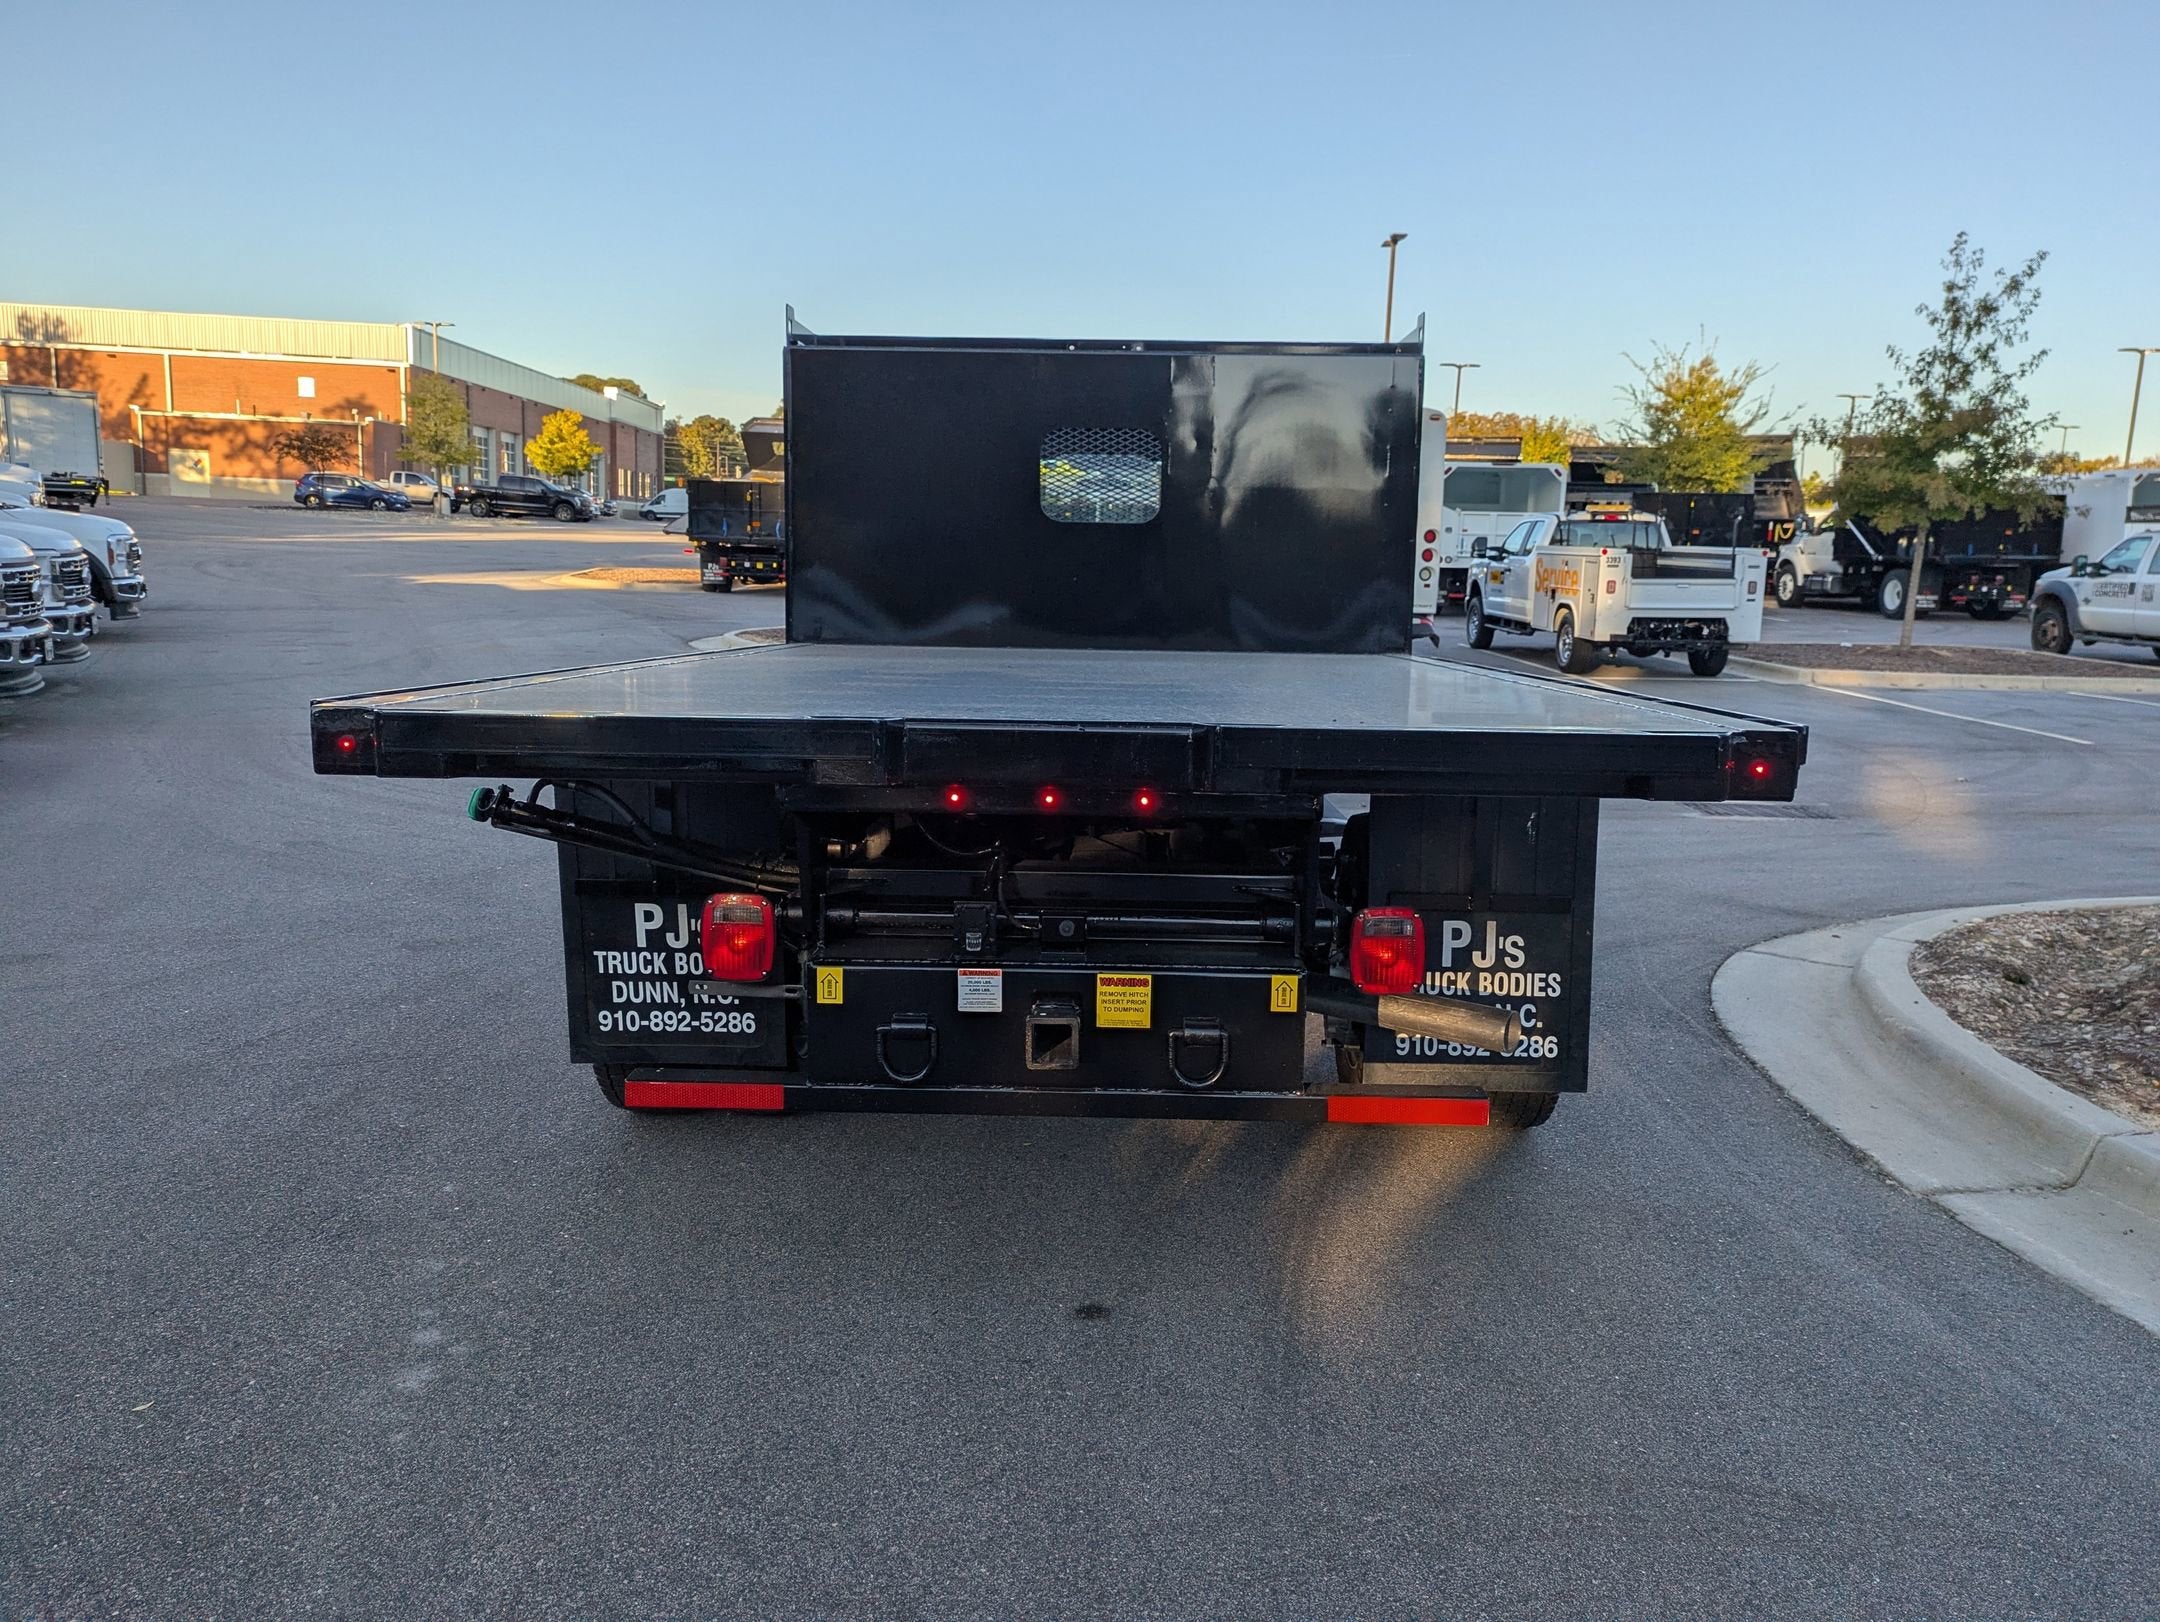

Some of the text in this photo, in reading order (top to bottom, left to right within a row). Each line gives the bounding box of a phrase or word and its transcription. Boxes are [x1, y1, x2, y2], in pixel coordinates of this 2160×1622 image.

[634, 902, 702, 949] PJ'
[593, 951, 668, 974] TRUCK
[1099, 976, 1149, 987] WARNING
[1478, 972, 1561, 997] BODIES
[612, 981, 686, 1007] DUNN,
[598, 1010, 756, 1034] 910-892-5286
